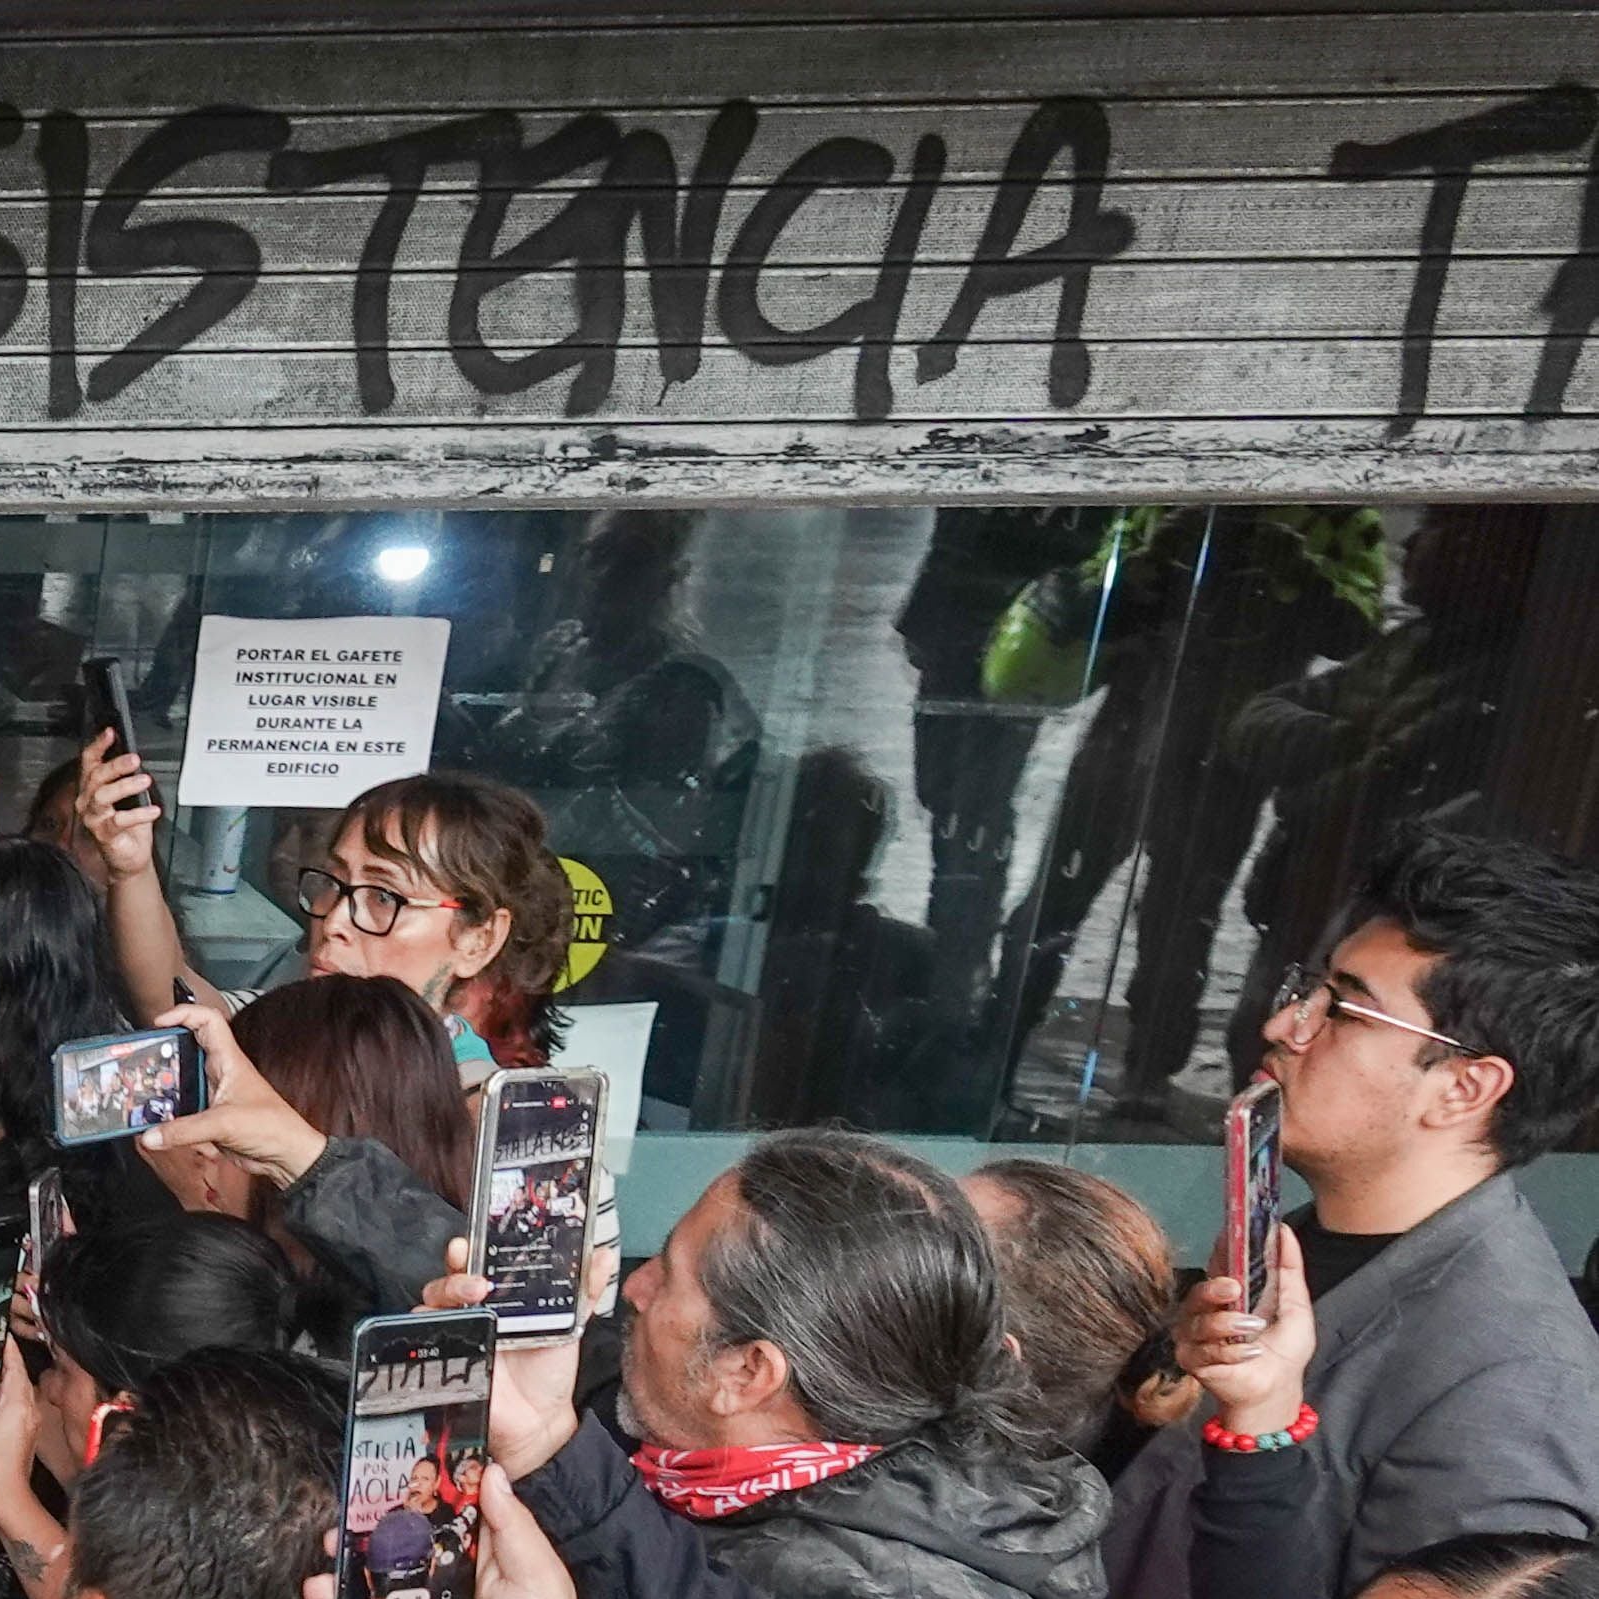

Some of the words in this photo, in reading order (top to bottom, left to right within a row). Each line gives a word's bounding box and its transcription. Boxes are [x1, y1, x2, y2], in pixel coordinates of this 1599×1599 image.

[236, 648, 304, 662] PORTAR
[310, 649, 331, 662] EL
[337, 650, 403, 663] GAFETE
[235, 671, 368, 685] INSTITUCIONAL
[374, 673, 397, 685] EN
[248, 694, 306, 707] LUGAR
[312, 695, 378, 708] VISIBLE
[256, 717, 337, 730] DURANTE
[342, 718, 363, 730] LA
[206, 739, 329, 752] PERMANENCIA
[335, 741, 358, 753] EN
[363, 741, 406, 754] ESTE
[266, 762, 340, 775] EDIFICIO
